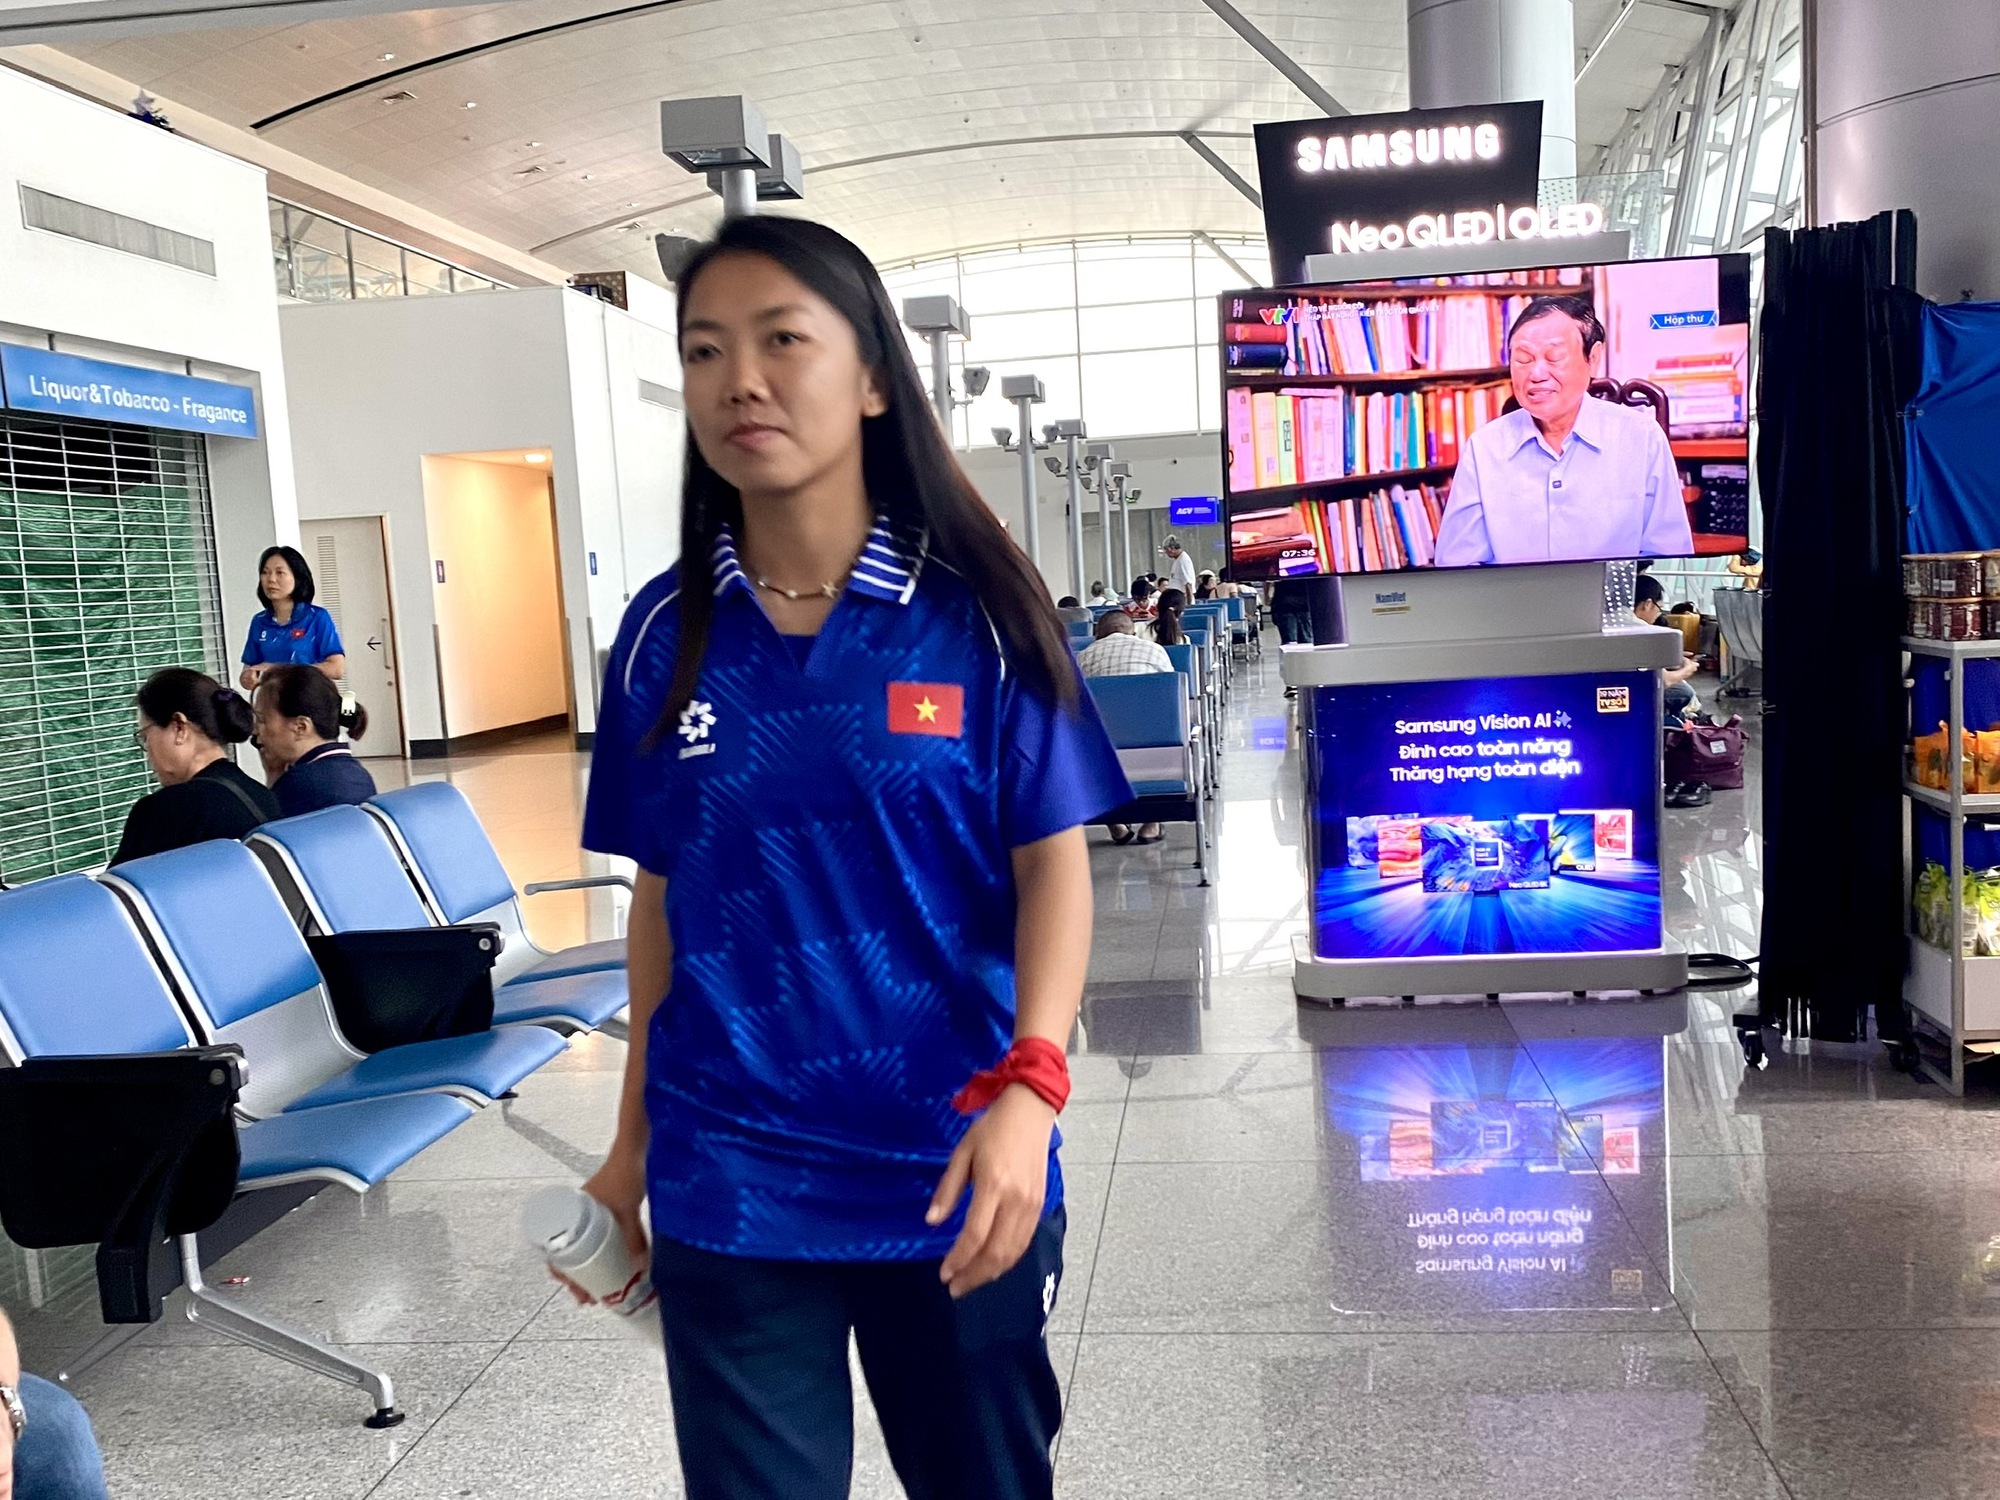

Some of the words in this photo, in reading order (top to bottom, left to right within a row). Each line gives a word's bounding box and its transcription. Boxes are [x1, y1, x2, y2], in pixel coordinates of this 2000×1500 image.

[1297, 122, 1500, 173] SAMSUNG
[1259, 307, 1300, 325] VTV1
[1664, 315, 1685, 326] Hộp
[1686, 313, 1705, 323] thư
[29, 374, 170, 413] Liquor&Tobacco
[182, 397, 247, 424] Fragance
[1282, 549, 1316, 558] 07:36
[1395, 720, 1476, 735] Samsung
[1479, 714, 1531, 730] Vision
[1534, 712, 1551, 728] AI
[1439, 745, 1474, 758] cao
[1476, 740, 1519, 757] toàn
[1522, 737, 1572, 758] năng
[1389, 765, 1444, 784] Thăng
[1447, 765, 1492, 783] hạng
[1494, 760, 1537, 777] toàn
[1539, 758, 1581, 779] điện
